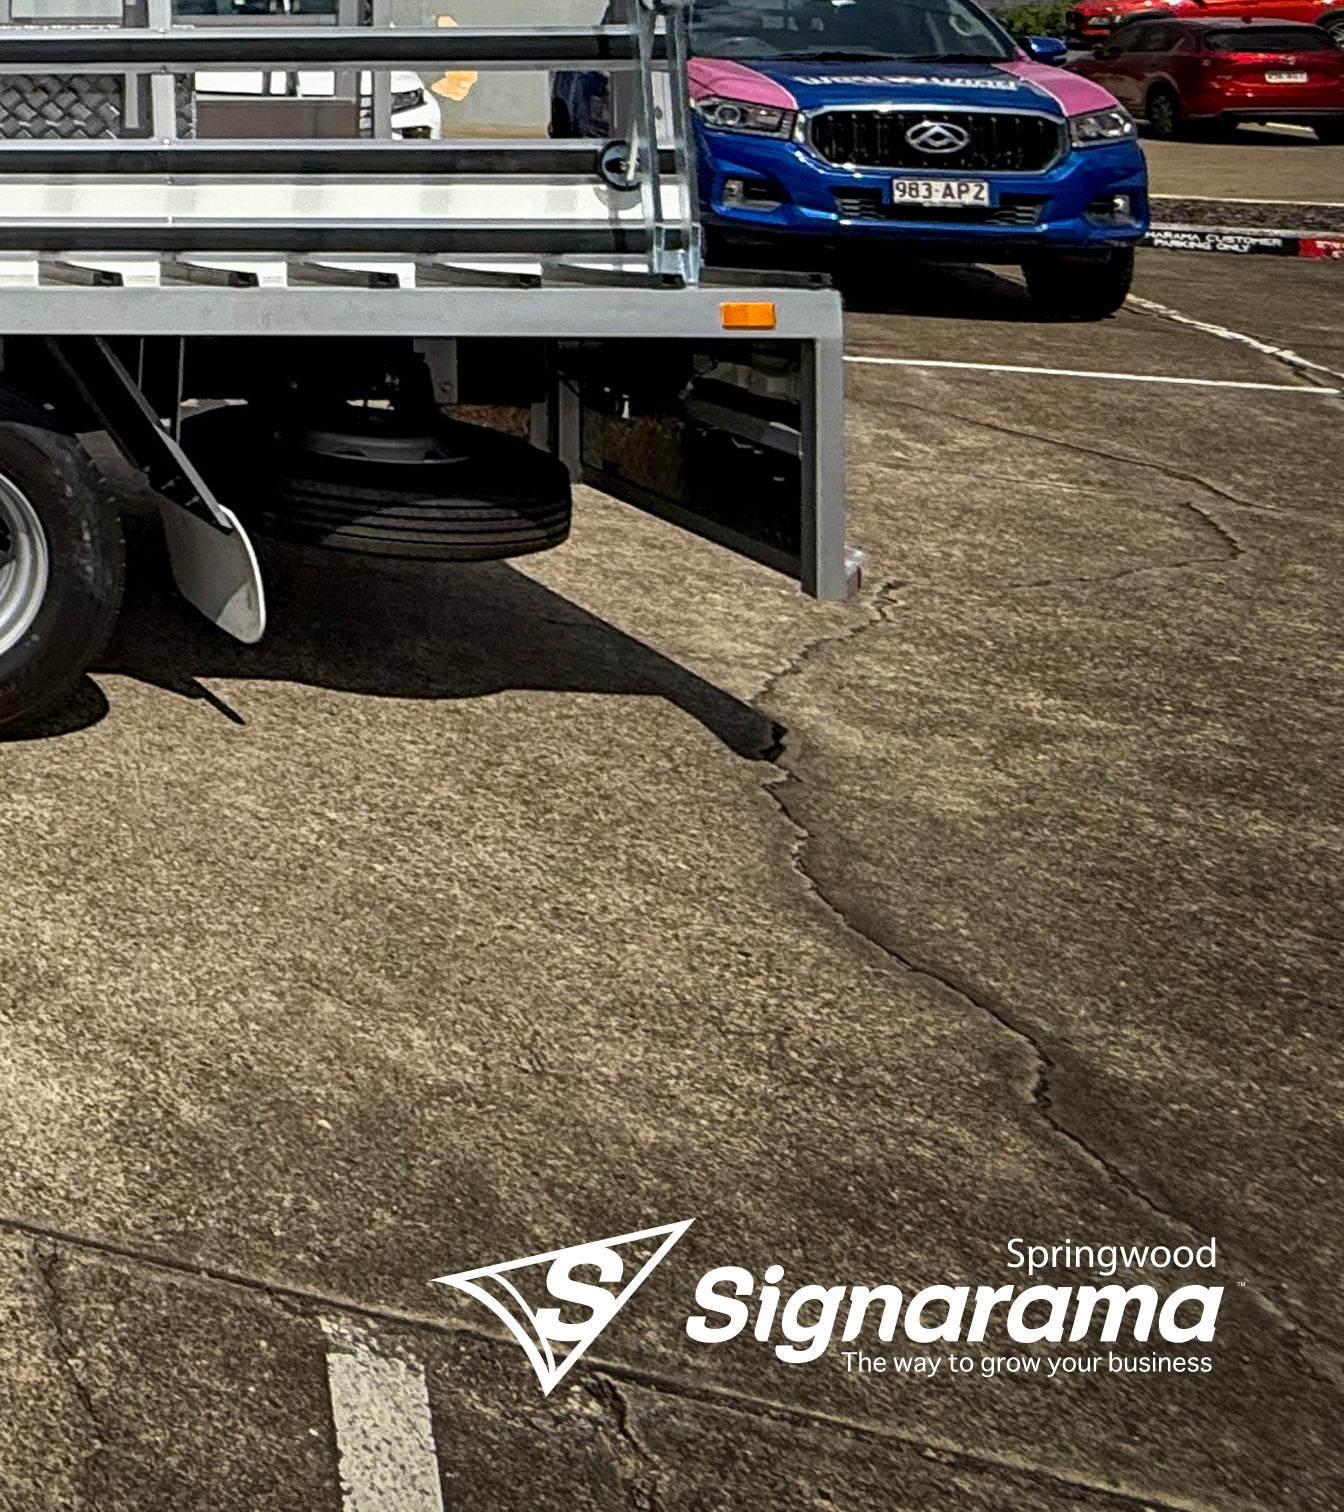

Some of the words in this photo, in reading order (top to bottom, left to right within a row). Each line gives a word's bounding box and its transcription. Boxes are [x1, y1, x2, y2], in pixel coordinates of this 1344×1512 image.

[1154, 239, 1213, 251] PARKING
[1216, 243, 1251, 253] ONLY
[1205, 233, 1283, 247] CUSTOMER
